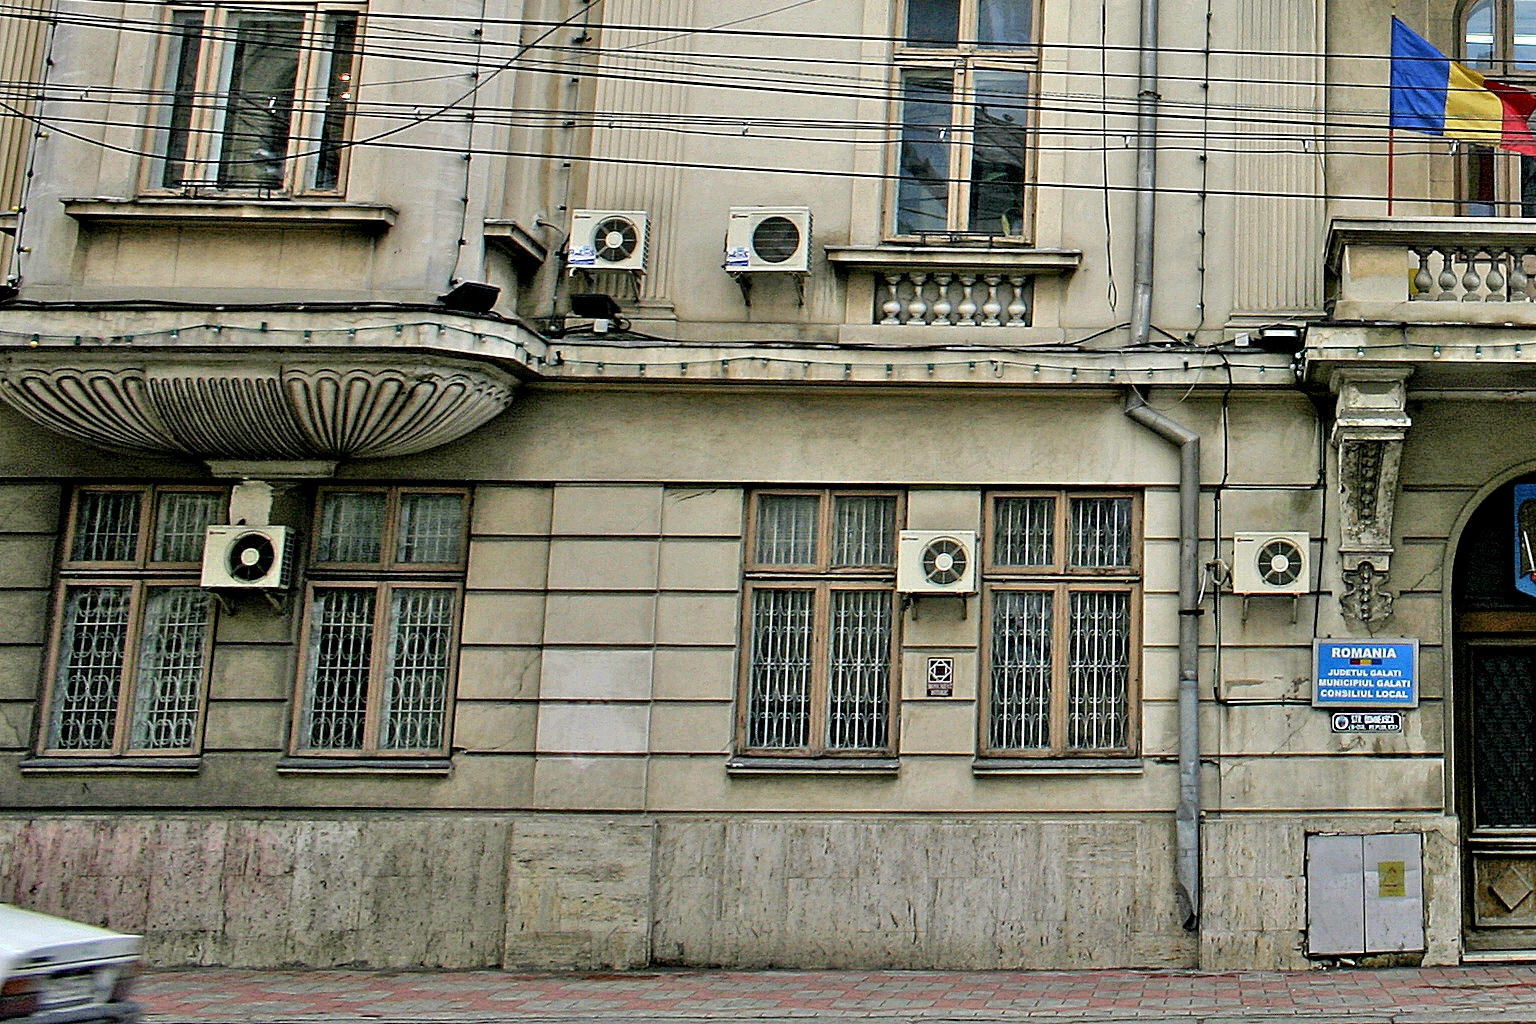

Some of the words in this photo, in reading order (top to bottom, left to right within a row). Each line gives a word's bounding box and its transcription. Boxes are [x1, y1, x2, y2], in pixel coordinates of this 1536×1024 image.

[1331, 647, 1397, 658] ROMANIA
[1327, 669, 1369, 677] JUDETUL
[1370, 669, 1402, 677] GALATI
[1318, 679, 1375, 687] MUNICIPIUL
[1376, 679, 1411, 687] GALATI
[1320, 689, 1374, 698] CONSILIUL
[1375, 690, 1409, 699] LOCAL
